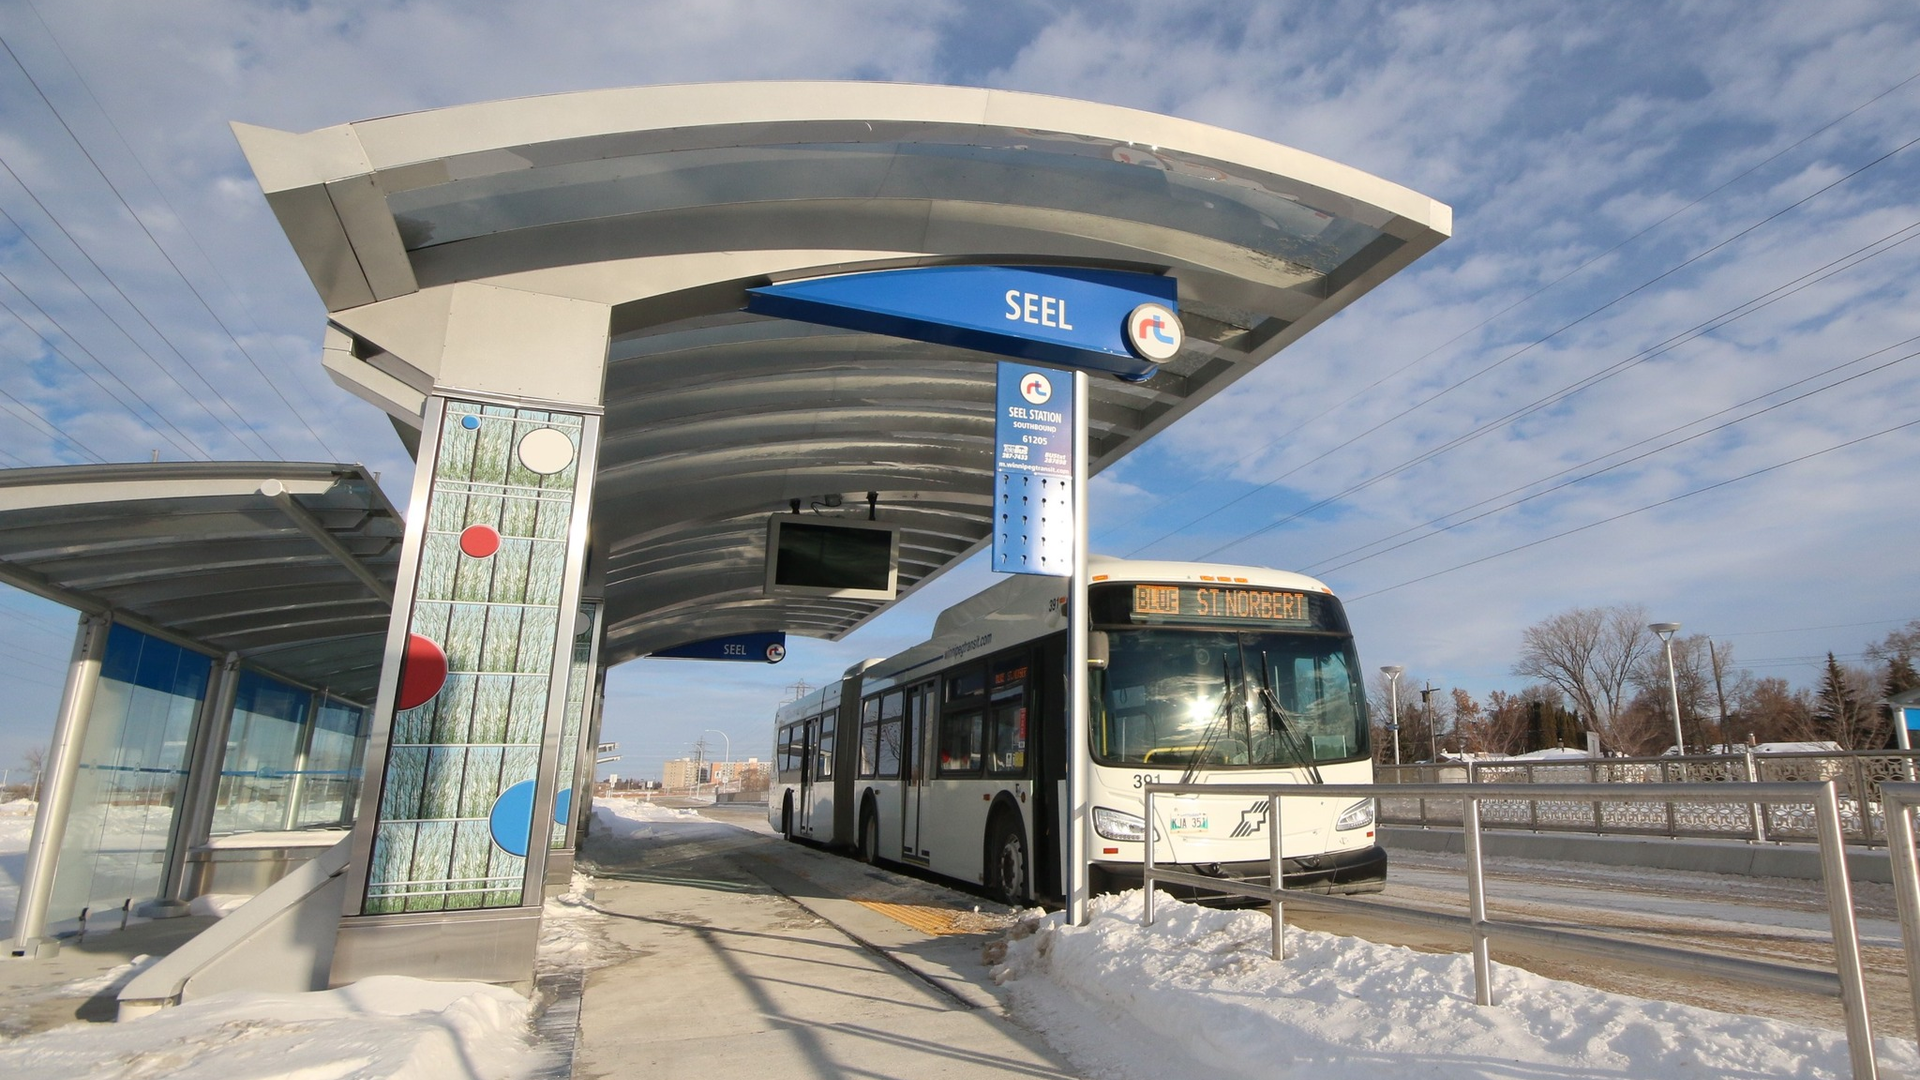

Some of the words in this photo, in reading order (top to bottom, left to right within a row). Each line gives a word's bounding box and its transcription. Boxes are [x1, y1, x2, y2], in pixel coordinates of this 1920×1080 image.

[1005, 289, 1073, 331] SEEL
[1008, 406, 1028, 419] SEEL
[1029, 409, 1062, 424] STATION
[1013, 421, 1057, 433] SOUTHBOUND
[1022, 435, 1048, 445] 61205
[998, 461, 1070, 474] m.winnipegtransit.com
[1048, 598, 1059, 612] 391
[1137, 586, 1177, 611] BLUE
[724, 644, 747, 655] SEEL
[1133, 774, 1160, 789] 391
